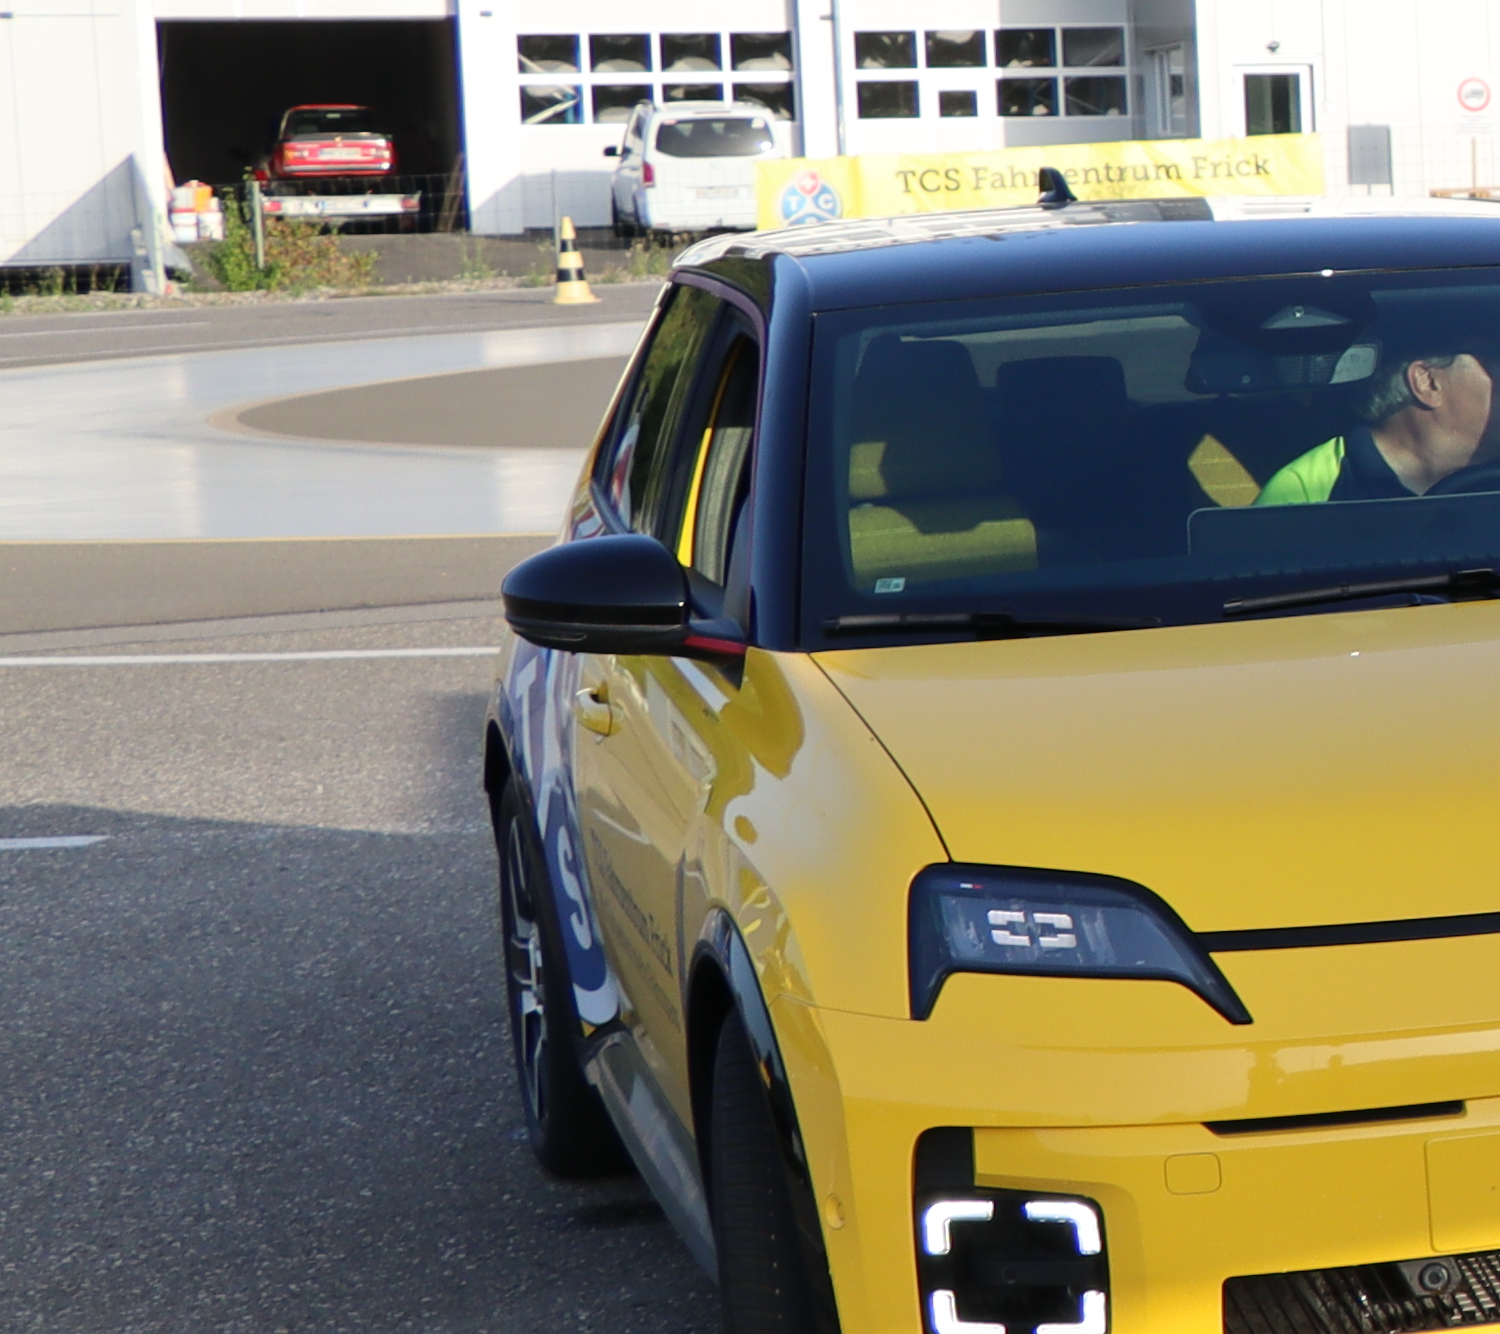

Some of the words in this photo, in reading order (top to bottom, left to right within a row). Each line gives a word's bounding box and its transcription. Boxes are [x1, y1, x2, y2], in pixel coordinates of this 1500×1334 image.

[896, 168, 961, 194] TCS
[973, 161, 1183, 191] Fahrentrum
[1192, 153, 1271, 180] Frick
